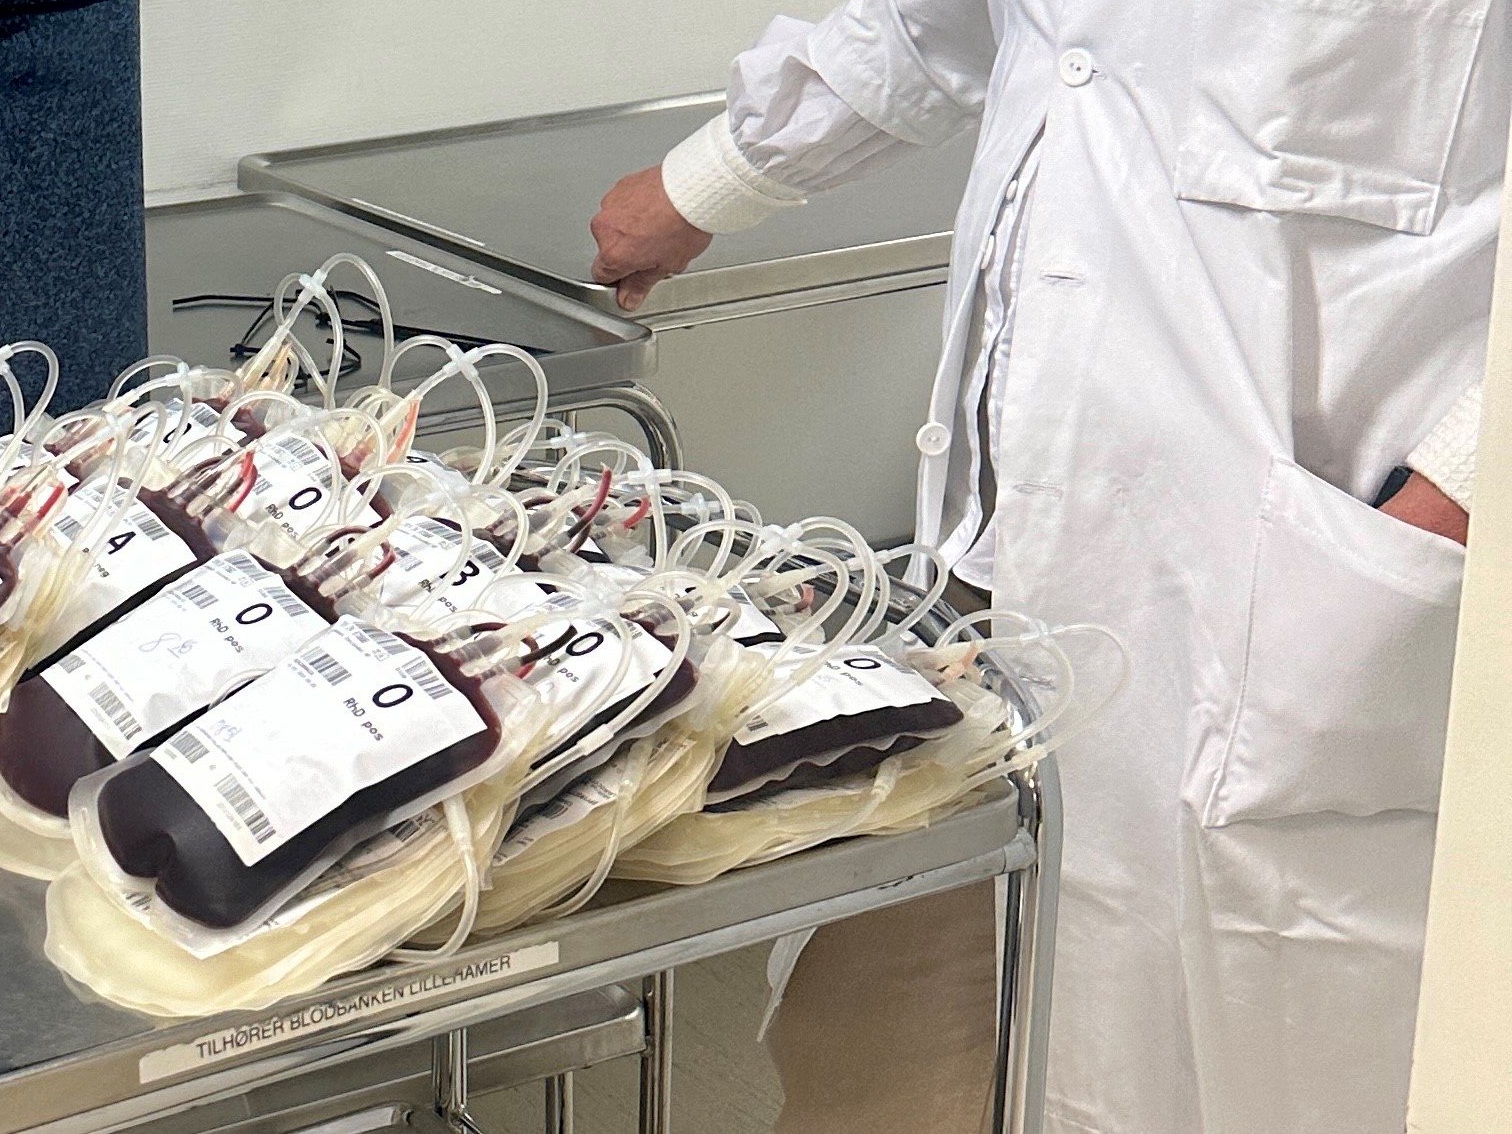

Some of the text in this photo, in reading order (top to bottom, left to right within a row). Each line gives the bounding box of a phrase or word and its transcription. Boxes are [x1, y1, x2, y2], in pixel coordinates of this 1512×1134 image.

[289, 487, 322, 510] O
[265, 503, 300, 539] RhD pos
[236, 603, 273, 625] O
[209, 618, 245, 654] RhD pos
[566, 632, 604, 657] O
[557, 667, 581, 684] pos
[372, 683, 414, 708] O
[343, 696, 385, 742] RhD pos
[195, 1019, 286, 1059] TILHØRER
[289, 987, 405, 1031] BLODBANKEN
